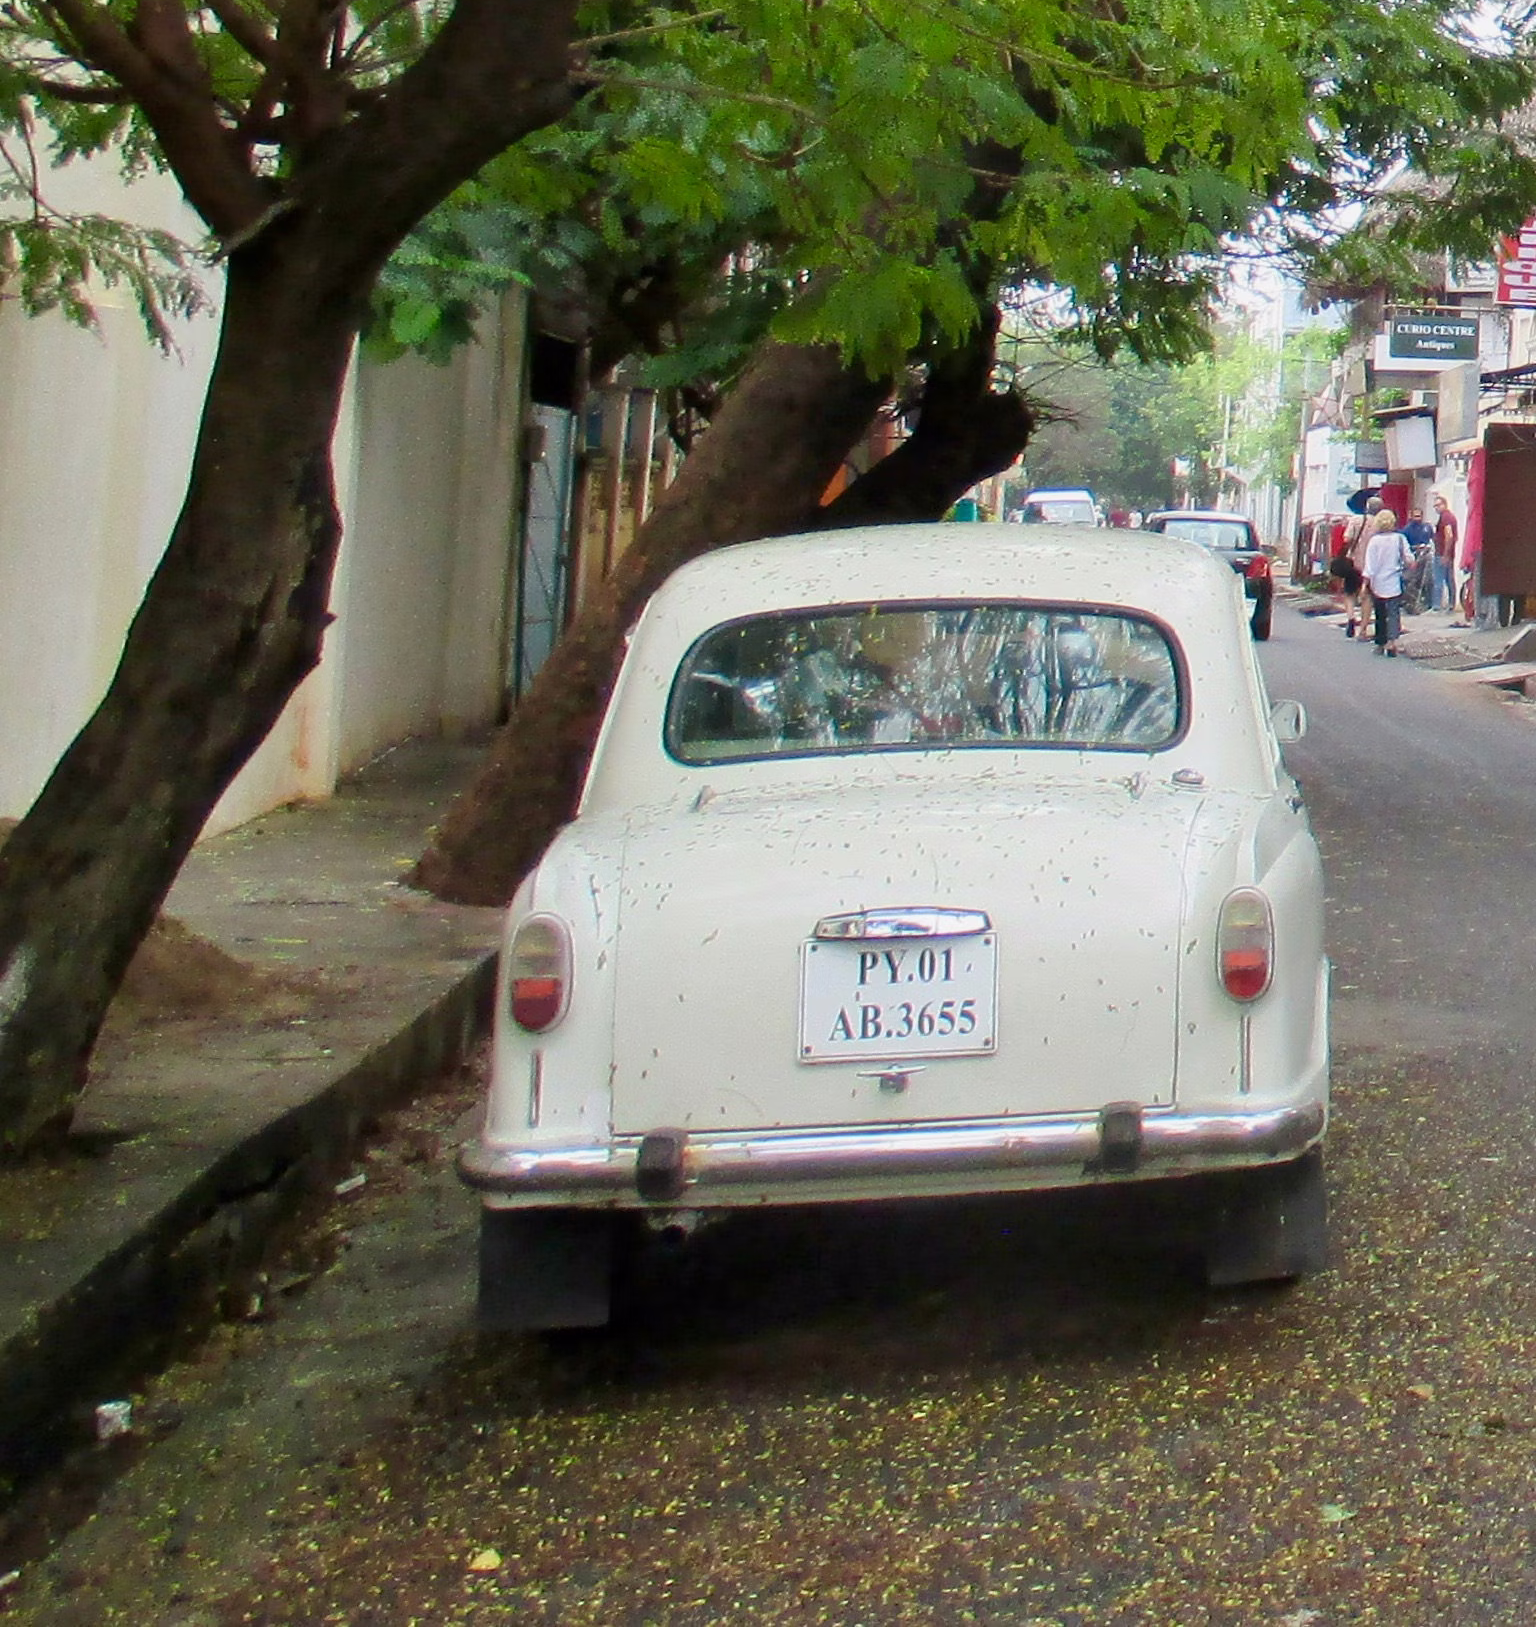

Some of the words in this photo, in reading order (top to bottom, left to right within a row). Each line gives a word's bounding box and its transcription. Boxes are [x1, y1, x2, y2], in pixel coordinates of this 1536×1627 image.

[1397, 324, 1431, 335] CURIO
[1432, 325, 1476, 336] CENTRE
[1415, 339, 1456, 351] Antiques
[857, 947, 955, 985] PY.01
[828, 999, 977, 1041] AB.3655
